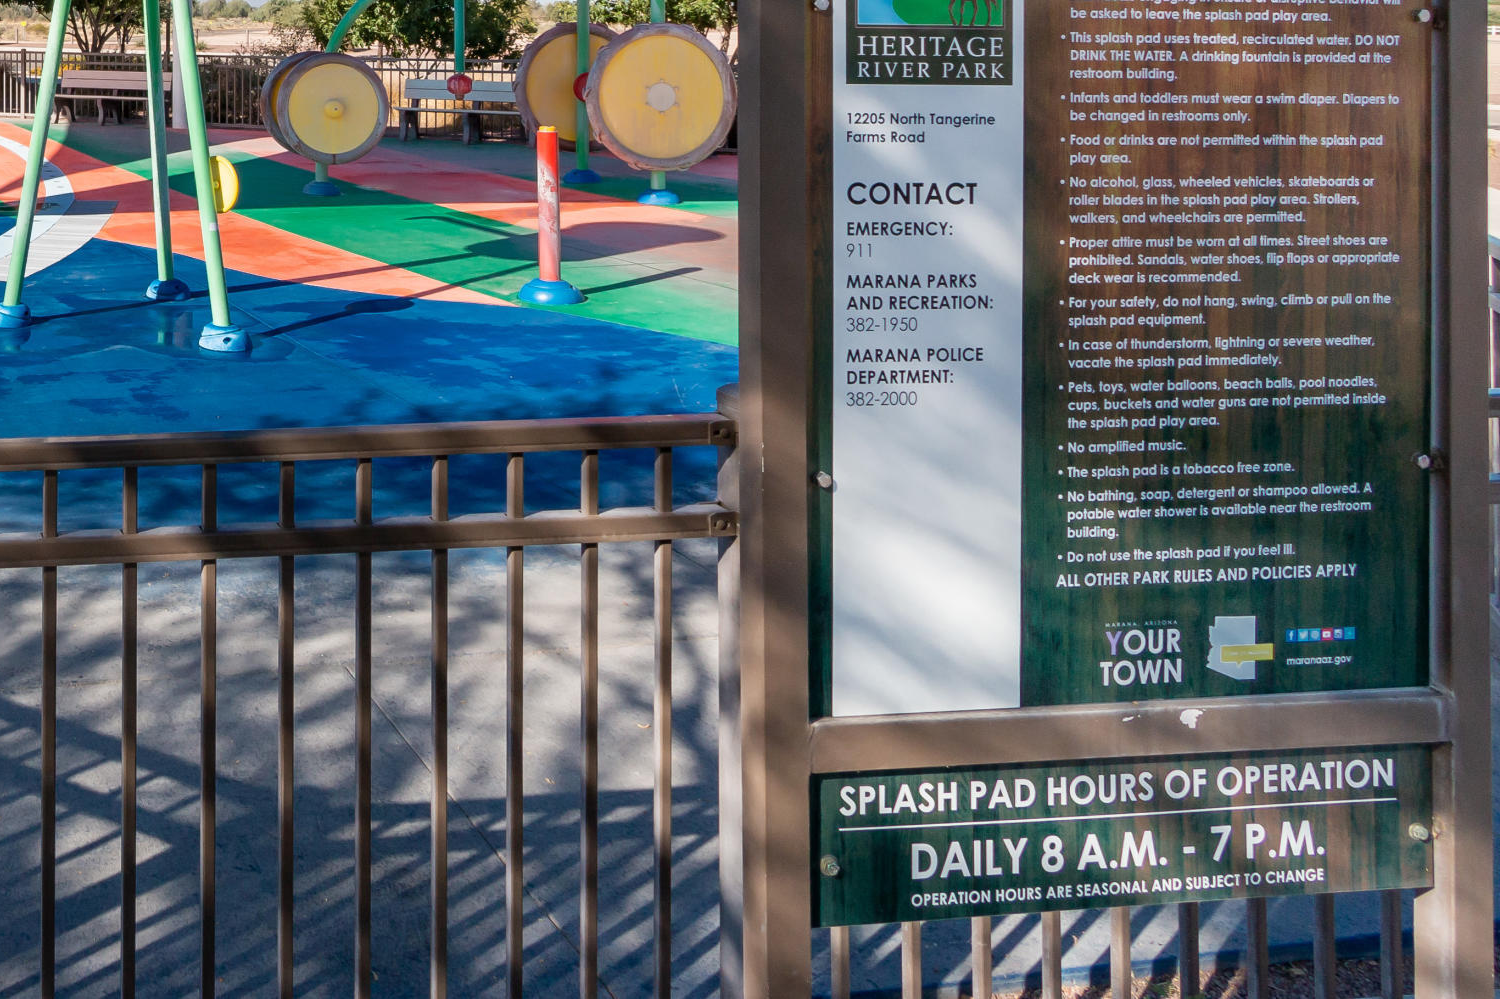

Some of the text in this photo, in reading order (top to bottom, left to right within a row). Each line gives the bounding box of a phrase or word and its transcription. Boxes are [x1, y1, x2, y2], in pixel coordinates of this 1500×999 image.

[1070, 31, 1400, 45] This splash pad uses treated, recirculated water. DO NOT
[857, 36, 1004, 57] HERITAGE
[1070, 49, 1391, 64] DRINK THE WATER. A drinking fountain is provided at the
[857, 61, 1004, 78] RIVER PARK
[1070, 67, 1177, 81] restroom building.
[847, 112, 995, 127] 12205 North Tangerine
[846, 130, 924, 142] Farms Road
[847, 182, 976, 204] CONTACT
[847, 221, 952, 236] EMERGENCY:
[846, 243, 871, 257] 911
[846, 274, 976, 288] MARANA PARKS
[846, 295, 992, 310] AND RECREATION:
[846, 316, 917, 332] 382-1950
[1068, 334, 1374, 350] In case of thunderstorm, lightning or severe weather,
[846, 347, 982, 362] MARANA POLICE
[1068, 353, 1281, 369] vacate the splash pad immediately.
[847, 369, 952, 384] DEPARTMENT:
[846, 390, 917, 406] 382-2000
[1068, 438, 1186, 454] No amplified music.
[1066, 461, 1294, 479] The splash pad is a tobacco free zone.
[1067, 525, 1118, 540] building.
[1067, 543, 1294, 562] Do not use the splash pad if you feel ill.
[1056, 563, 1356, 587] ALL OTHER PARK RULES AND POLICIES APPLY
[1105, 628, 1181, 656] YOUR
[1286, 655, 1351, 666] maranaaz.gov
[1099, 658, 1182, 686] TOWN
[839, 758, 1392, 816] SPLASH PAD HOURS OF OPERATION
[911, 836, 1028, 879] DAILY
[1041, 834, 1064, 873] 8
[1077, 829, 1167, 870] A.M.
[1210, 825, 1231, 861] 7
[1246, 819, 1324, 859] P.M.
[911, 867, 1323, 907] OPERATION HOURS ARE SEASONAL AND SUBJECT TO CHANGE
